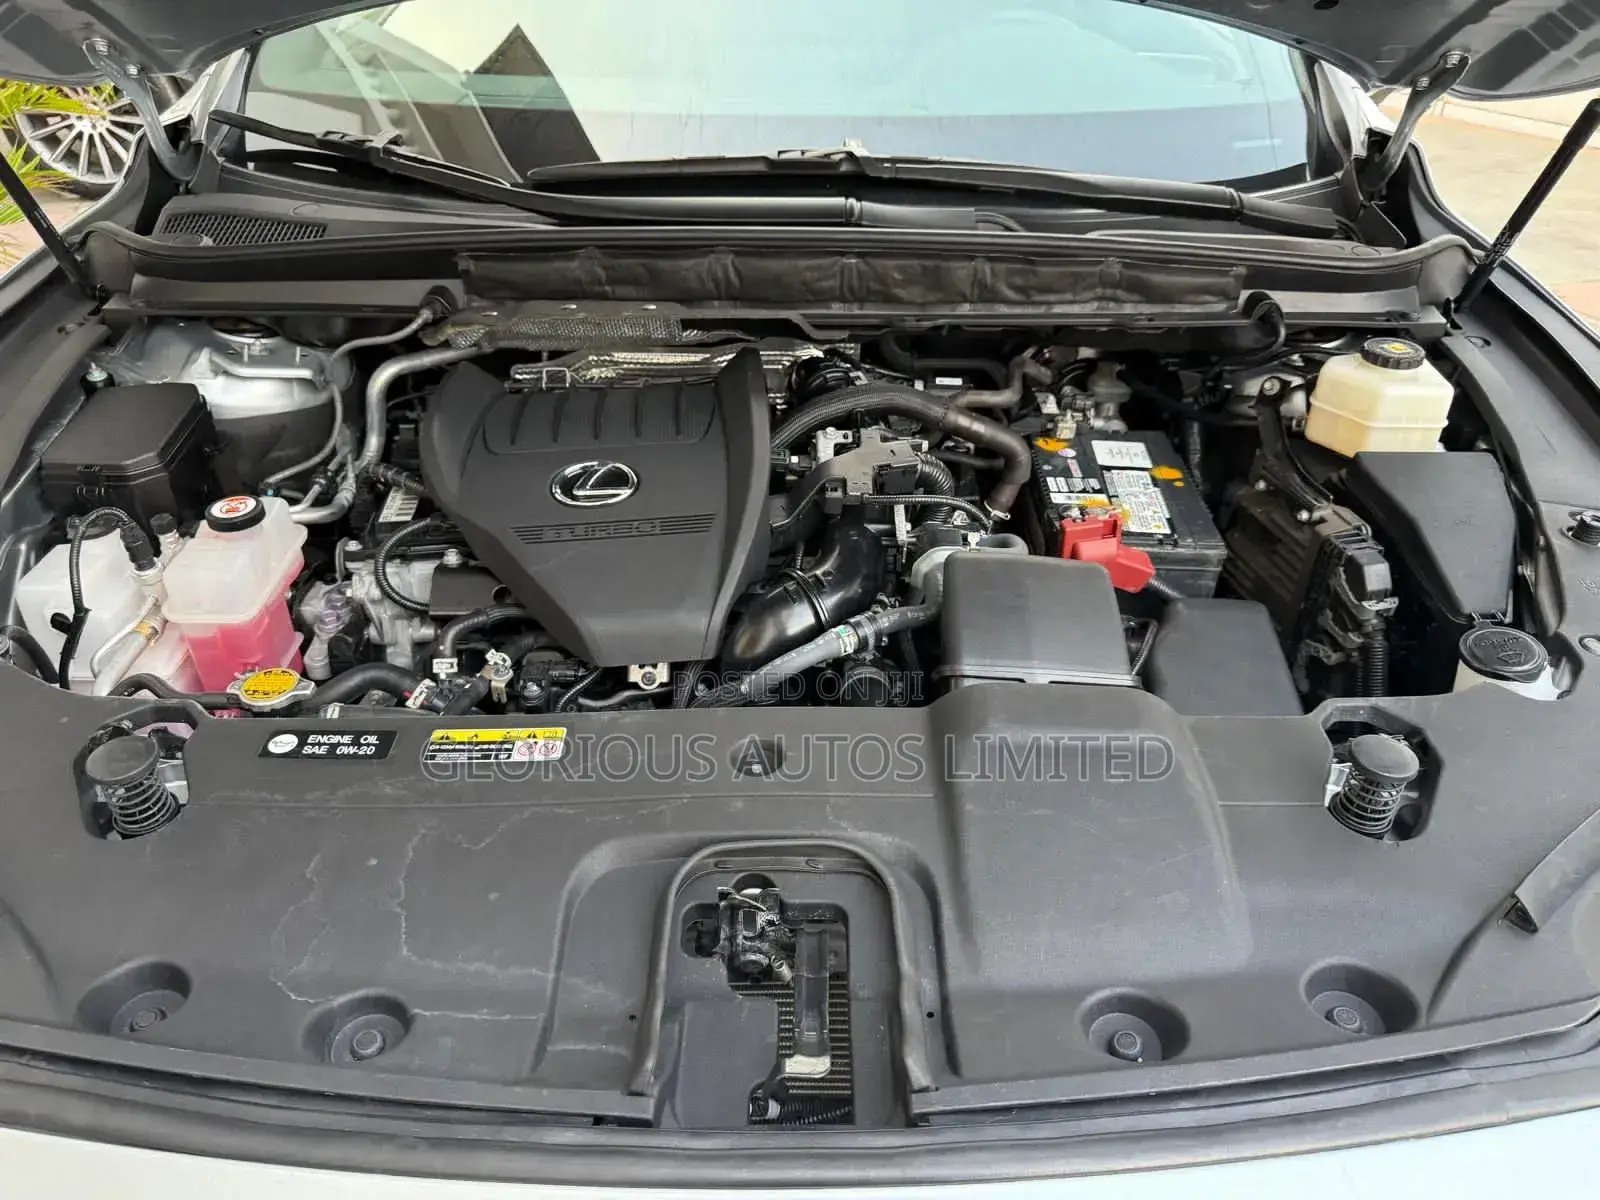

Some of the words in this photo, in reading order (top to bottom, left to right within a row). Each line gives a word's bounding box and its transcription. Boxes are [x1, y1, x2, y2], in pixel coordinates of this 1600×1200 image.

[543, 521, 660, 540] TURBO
[306, 735, 355, 744] ENGINE
[360, 735, 380, 744] OIL
[302, 745, 330, 754] SAE
[335, 745, 376, 755] 0W-20
